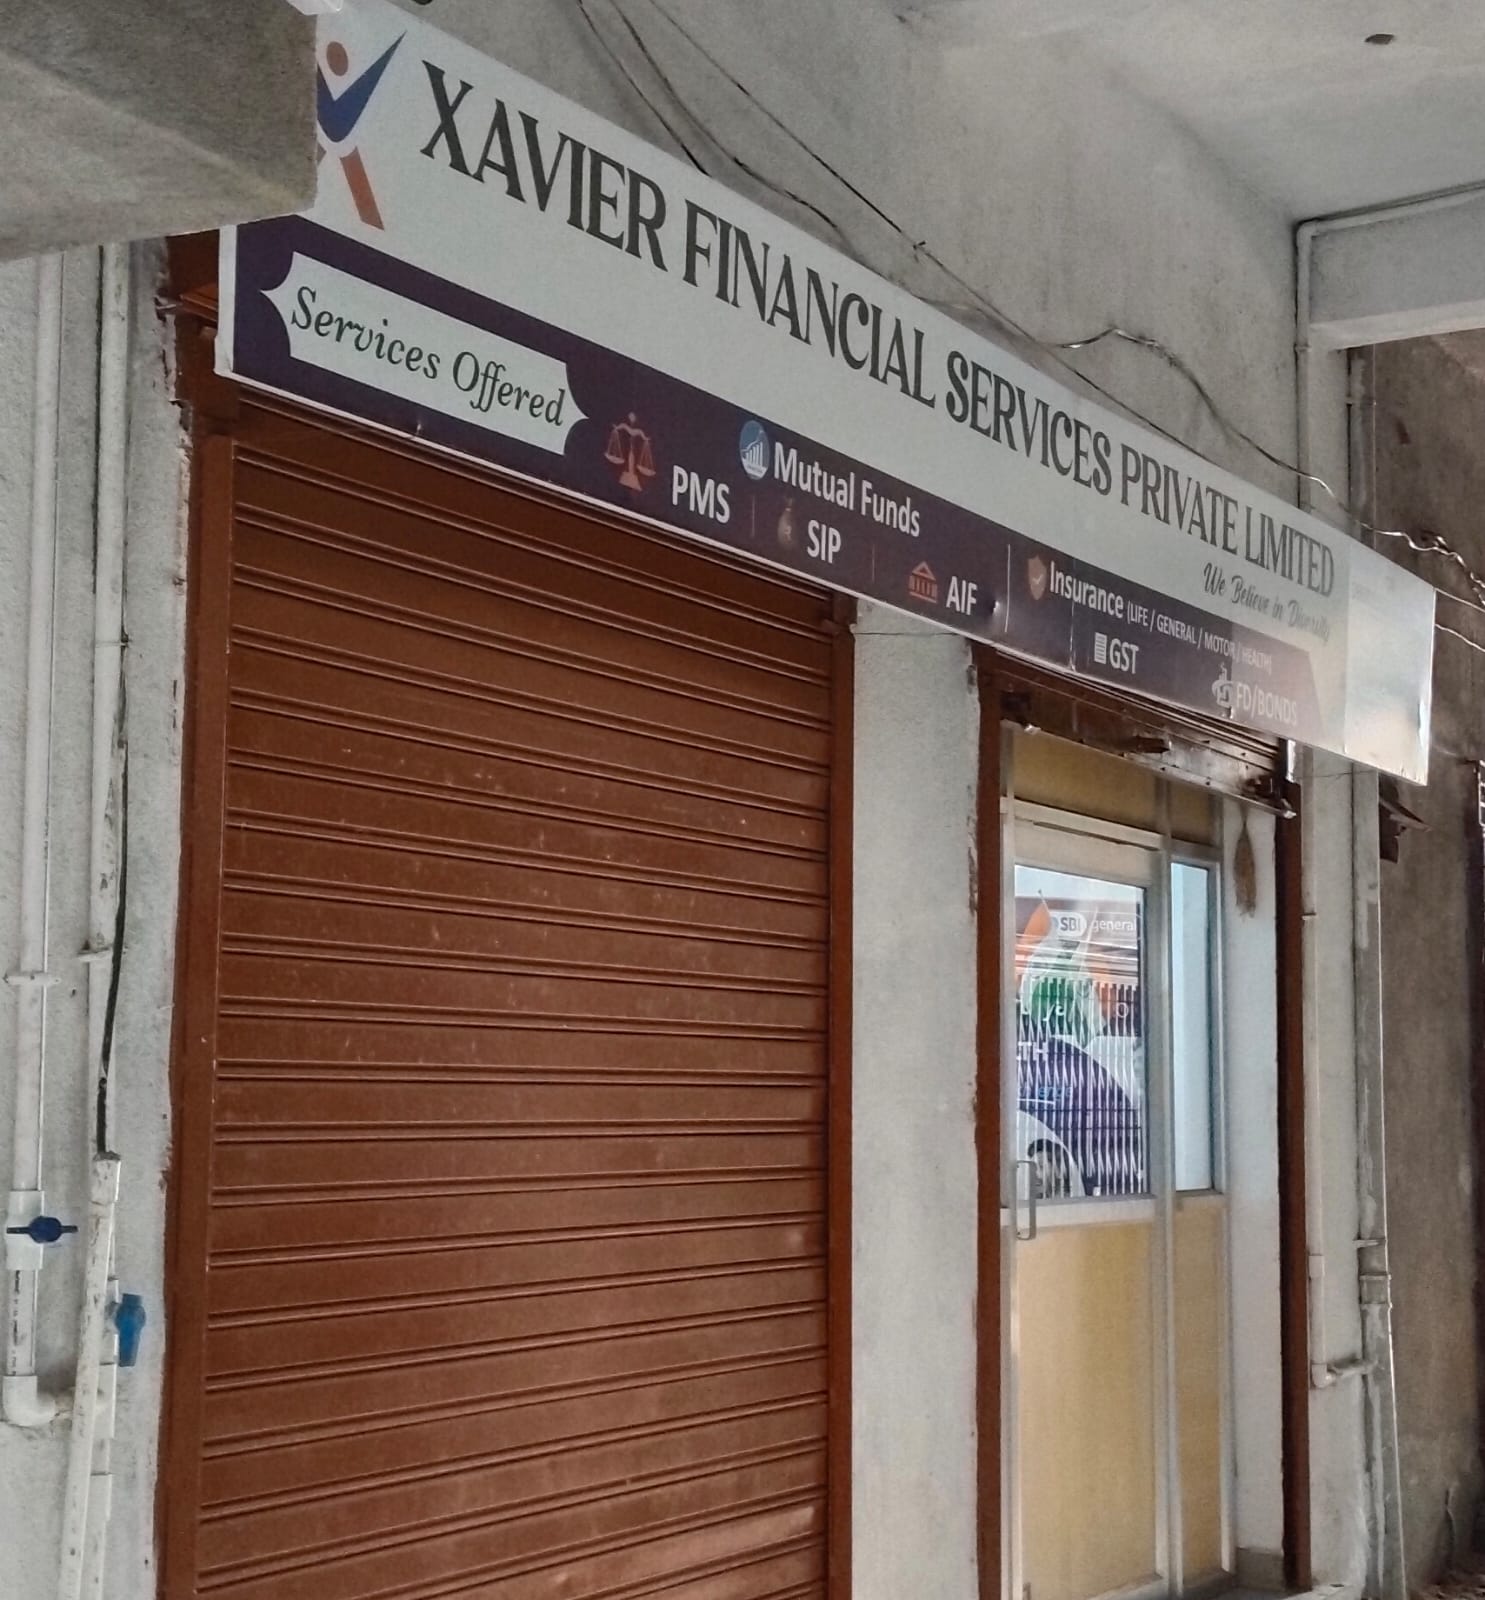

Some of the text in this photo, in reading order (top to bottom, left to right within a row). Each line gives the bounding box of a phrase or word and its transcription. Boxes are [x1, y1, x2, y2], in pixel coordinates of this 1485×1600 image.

[420, 60, 1335, 598] XAVIER FINANCIAL SERVICES PRIVATE LIMITED
[290, 286, 566, 428] Services Offered
[672, 465, 731, 524] PMS
[774, 441, 921, 538] Mutual Funds
[807, 519, 842, 564] SIP
[946, 576, 978, 616] AIF
[1203, 562, 1226, 597] We
[1050, 560, 1124, 619] Insurance
[1127, 600, 1149, 626] (LIFE
[1157, 614, 1197, 645] GENERAL
[1205, 632, 1236, 659] MOTOR
[1109, 638, 1140, 674] GST
[1236, 682, 1298, 727] FD/BONDS
